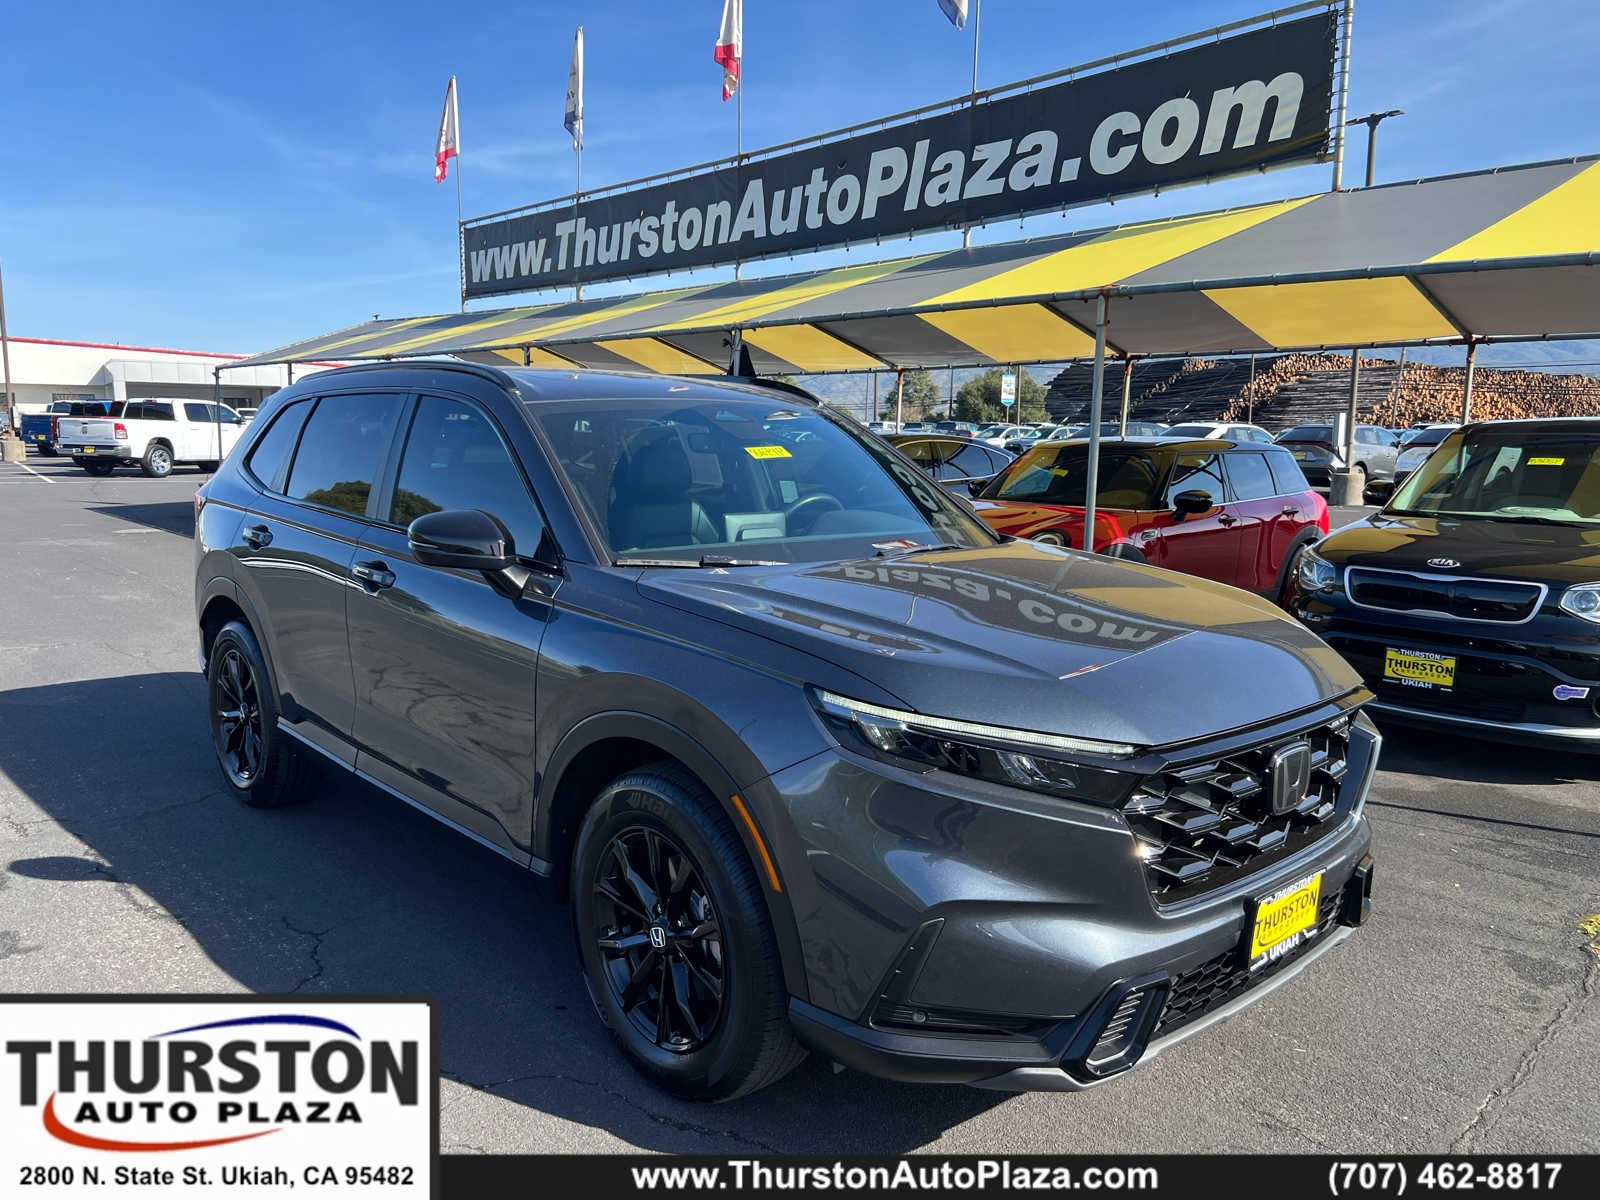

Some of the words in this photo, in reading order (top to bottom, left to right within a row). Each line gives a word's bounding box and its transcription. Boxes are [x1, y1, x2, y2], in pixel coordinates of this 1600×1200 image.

[470, 71, 1304, 283] www.ThurstonAutoPlaza.com
[1400, 648, 1442, 660] THURSTON
[1387, 657, 1454, 678] THURSTON
[1401, 678, 1433, 689] UKIAH
[1254, 887, 1318, 939] THURSTON
[1269, 932, 1299, 961] UKIAH
